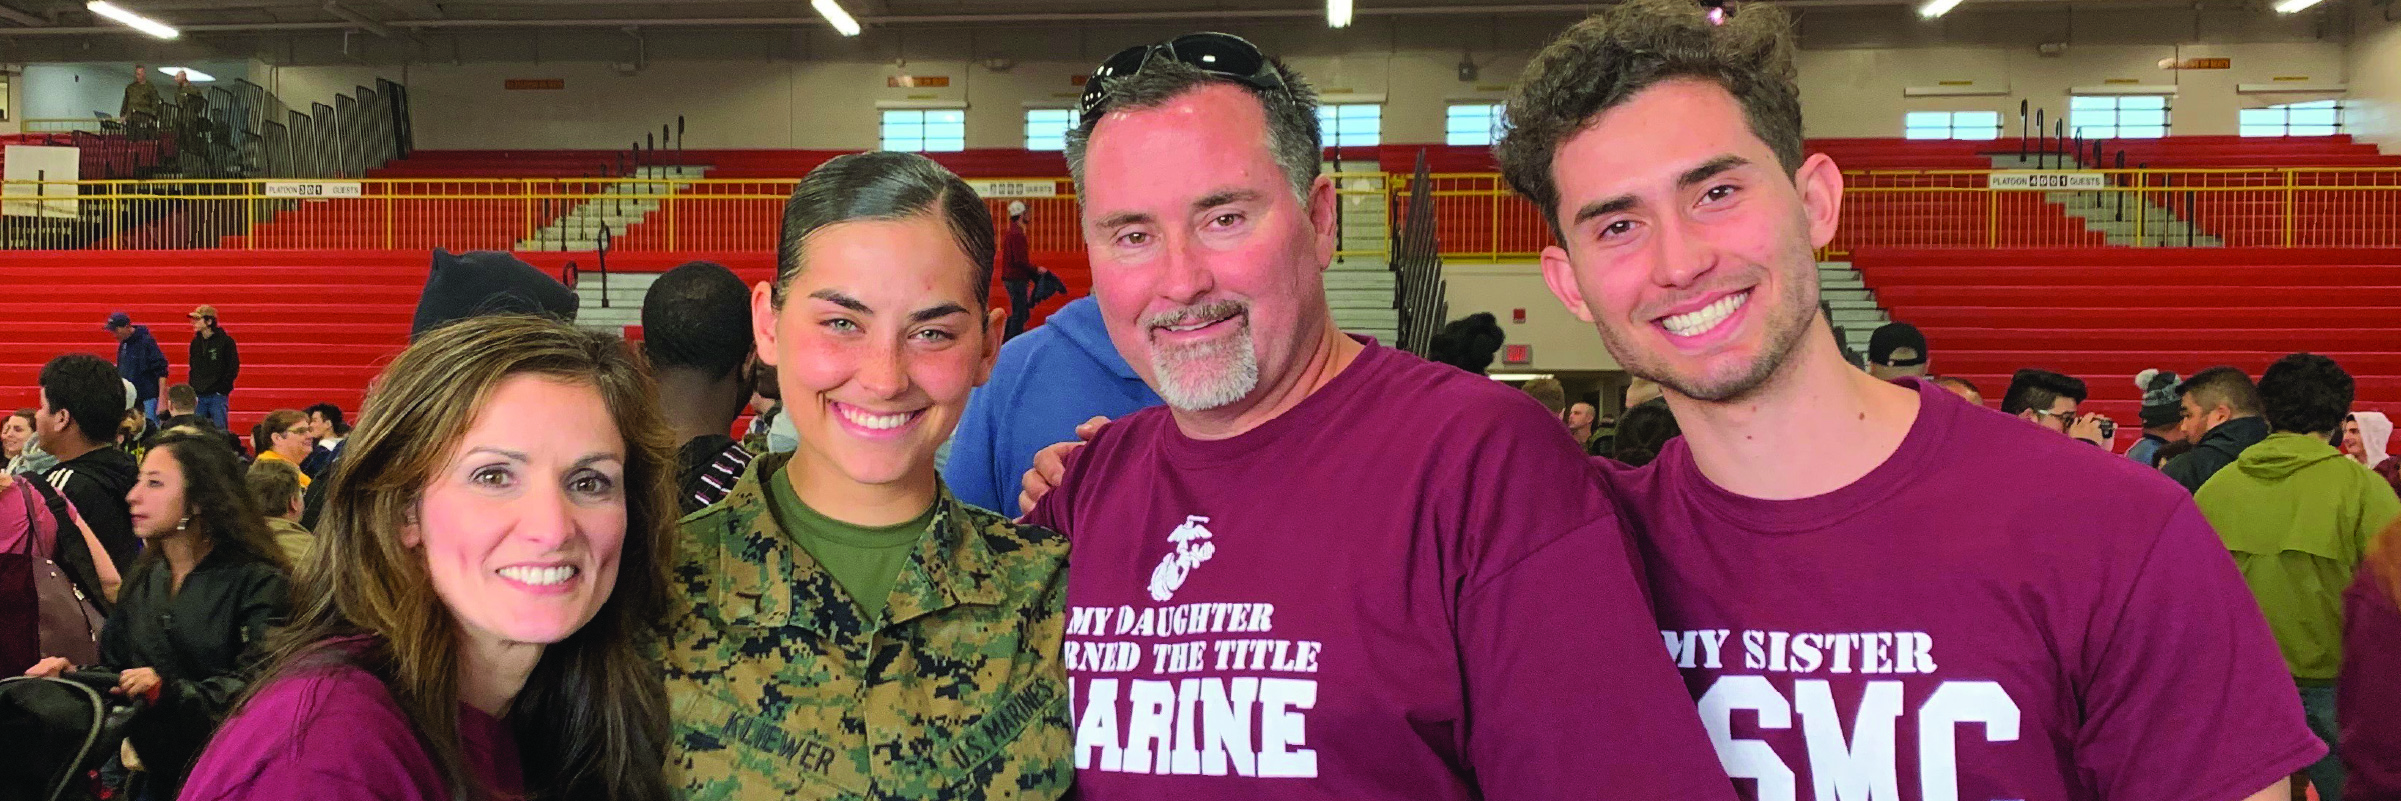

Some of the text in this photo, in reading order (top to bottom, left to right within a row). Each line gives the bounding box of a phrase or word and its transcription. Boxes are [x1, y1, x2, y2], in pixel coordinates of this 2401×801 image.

[269, 186, 297, 194] PLATOON
[333, 186, 359, 194] GUESTS
[1992, 175, 2027, 187] PLATOON
[2070, 176, 2101, 187] GUESTS
[1066, 602, 1275, 637] MY DAUGHTER
[1064, 639, 1322, 674] RNED THE TITLE
[1660, 629, 1937, 674] MY SISTER
[721, 711, 835, 776] KLIEWER
[1698, 675, 2021, 801] SMC
